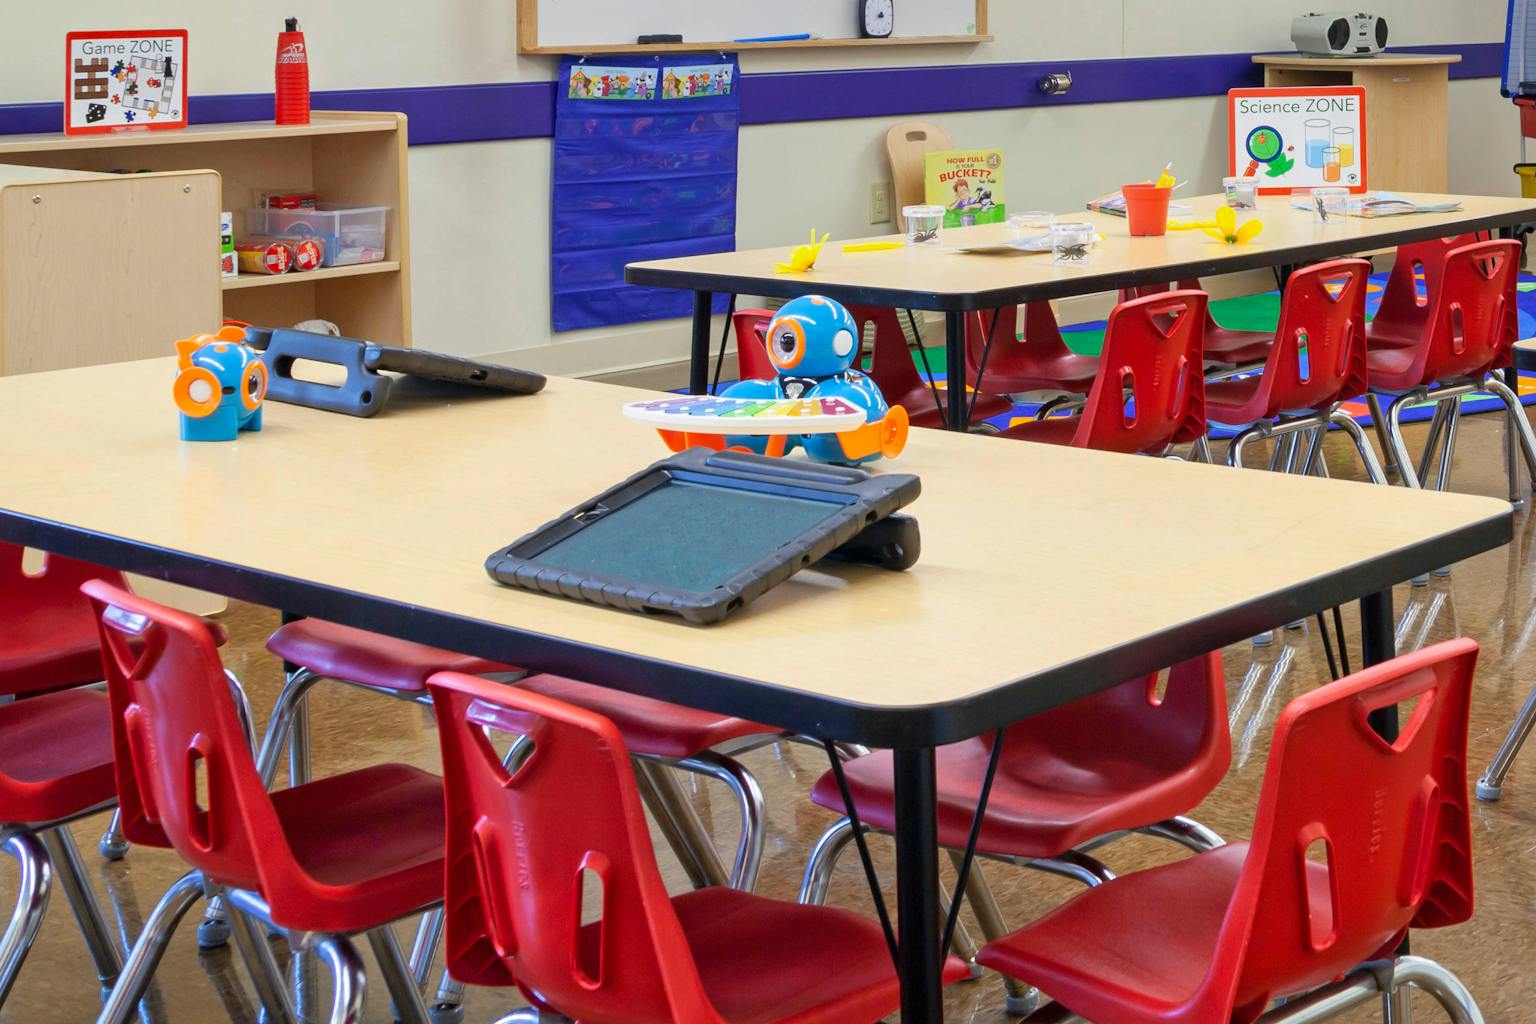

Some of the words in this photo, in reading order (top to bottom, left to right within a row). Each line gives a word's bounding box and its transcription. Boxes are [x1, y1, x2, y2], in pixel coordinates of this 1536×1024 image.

[82, 40, 125, 56] Game
[130, 39, 174, 54] ZONE
[1240, 98, 1300, 114] Science
[1305, 97, 1355, 112] ZONE
[939, 169, 991, 183] BUCKET?
